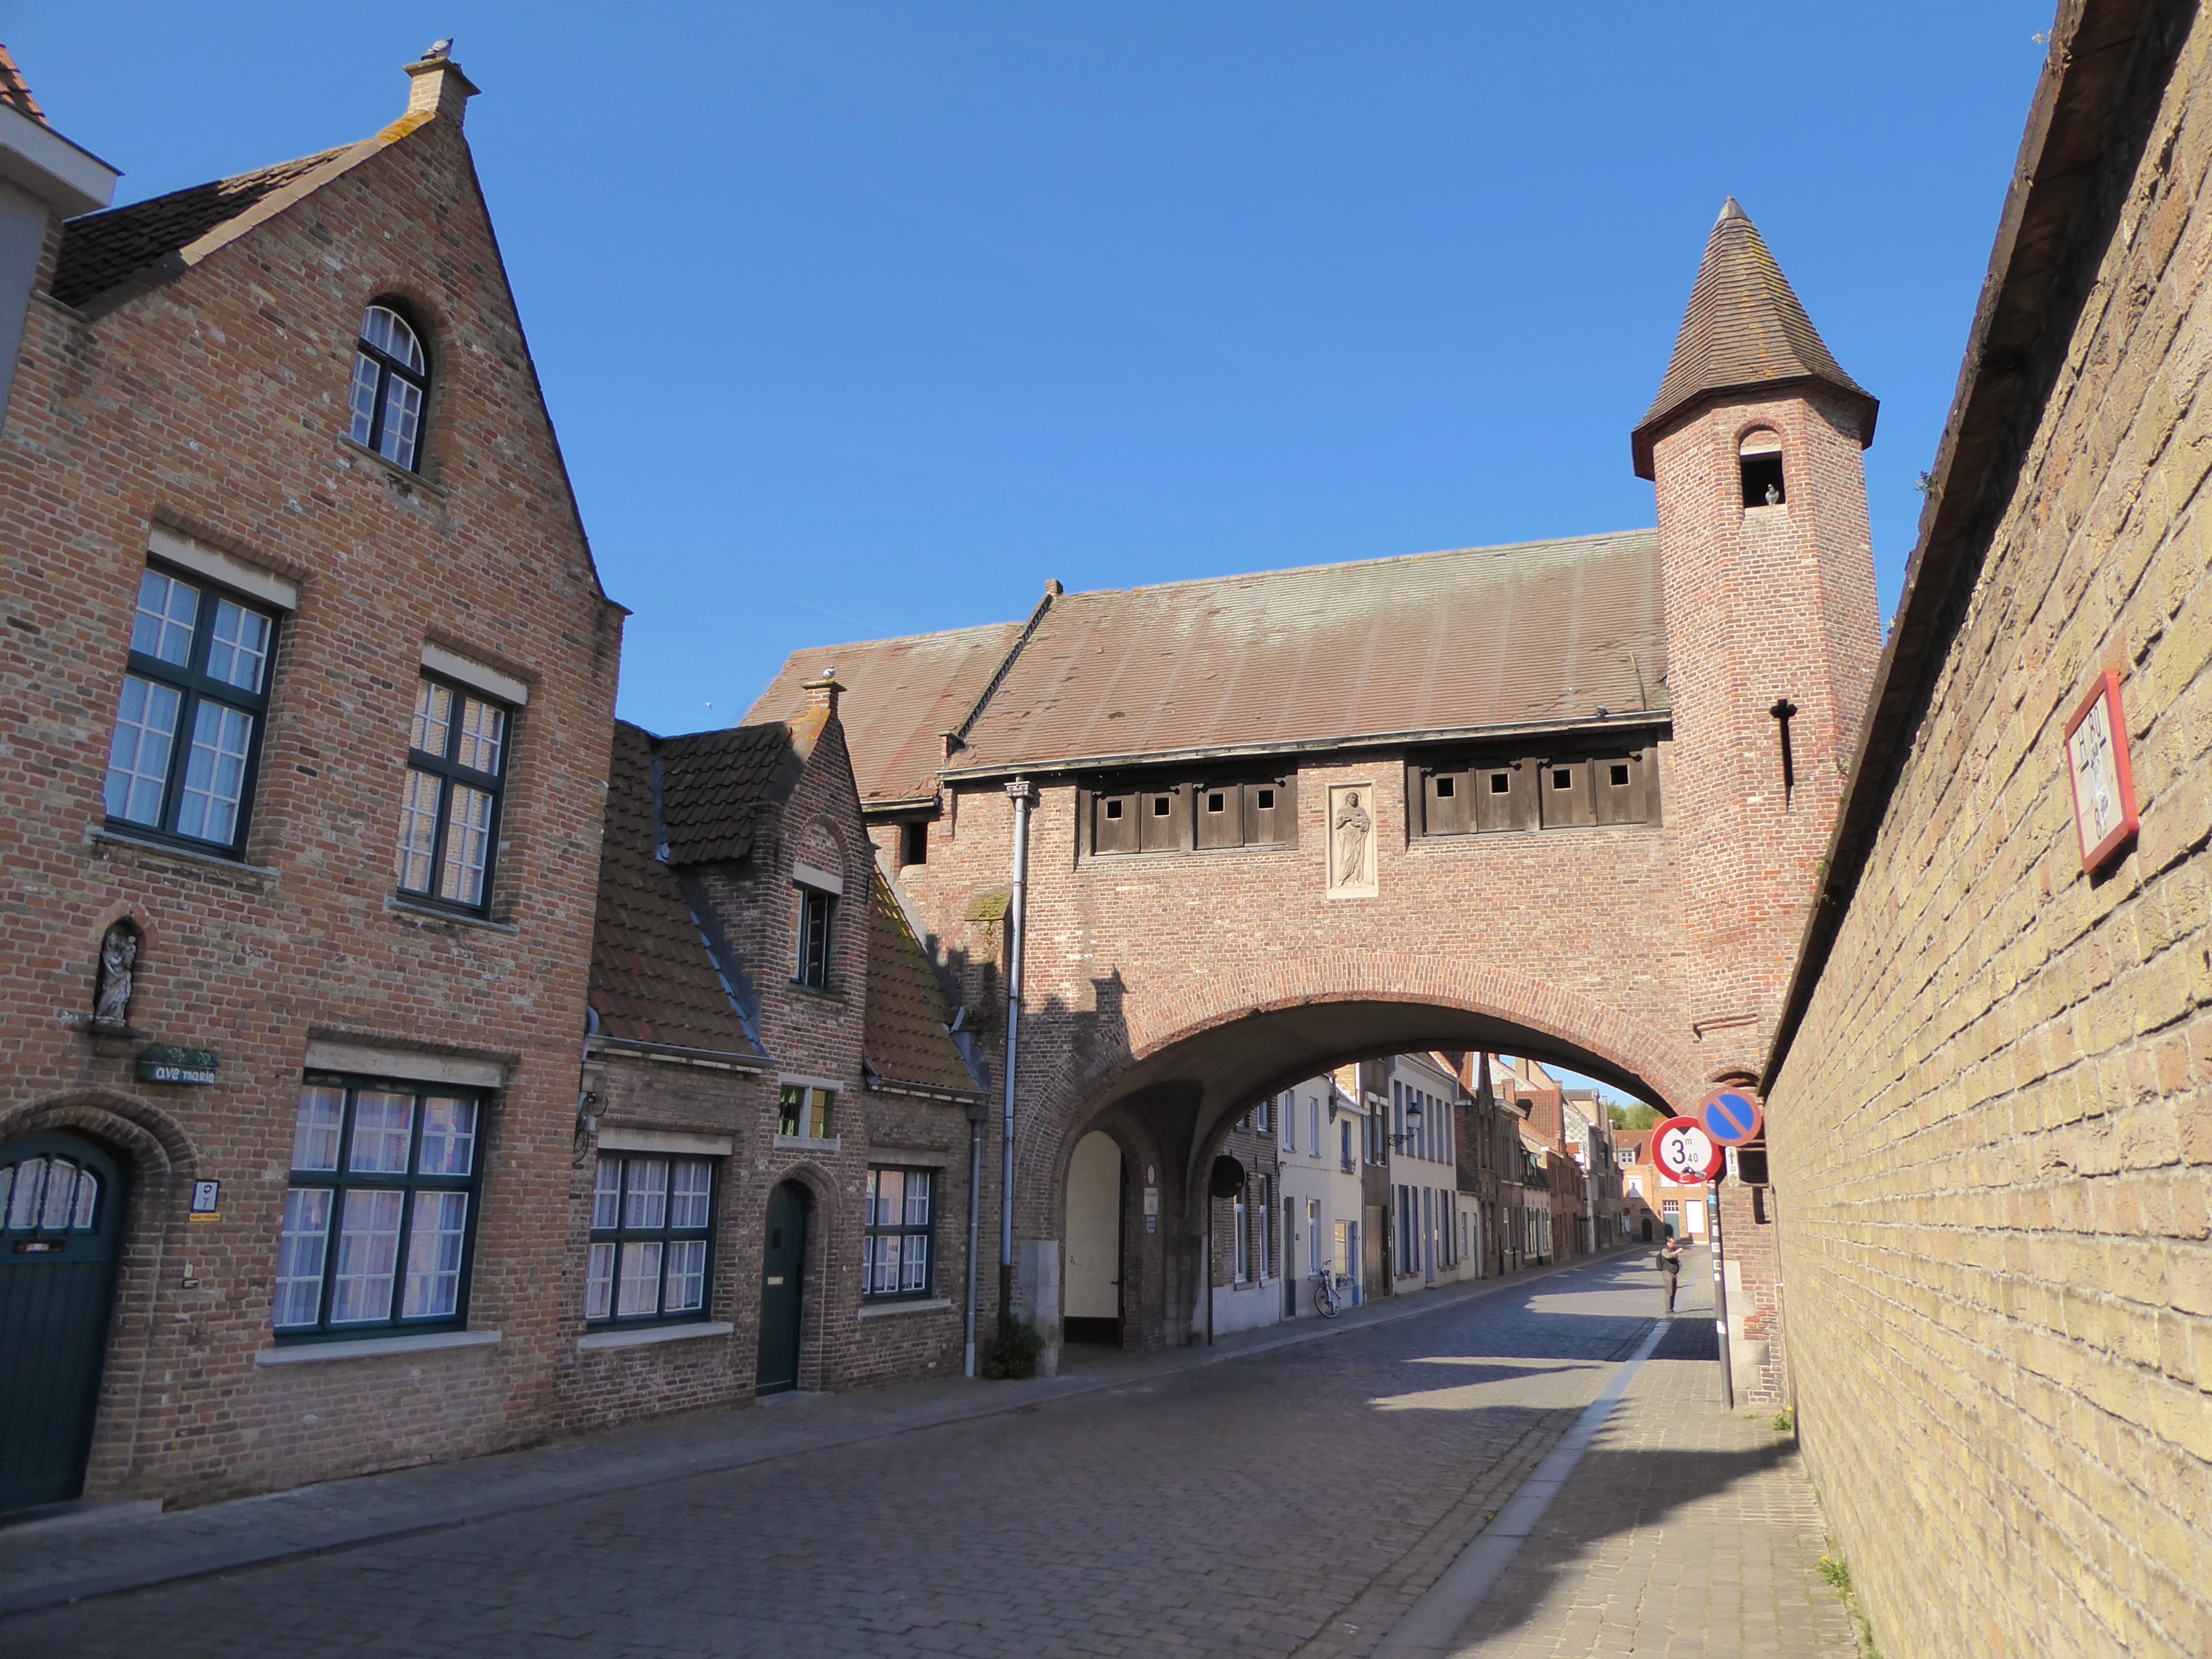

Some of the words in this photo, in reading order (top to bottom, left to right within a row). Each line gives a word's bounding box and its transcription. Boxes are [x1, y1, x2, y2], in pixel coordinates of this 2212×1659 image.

[156, 1067, 180, 1080] ave
[1672, 1139, 1686, 1164] 3
[1688, 1153, 1698, 1162] 40
